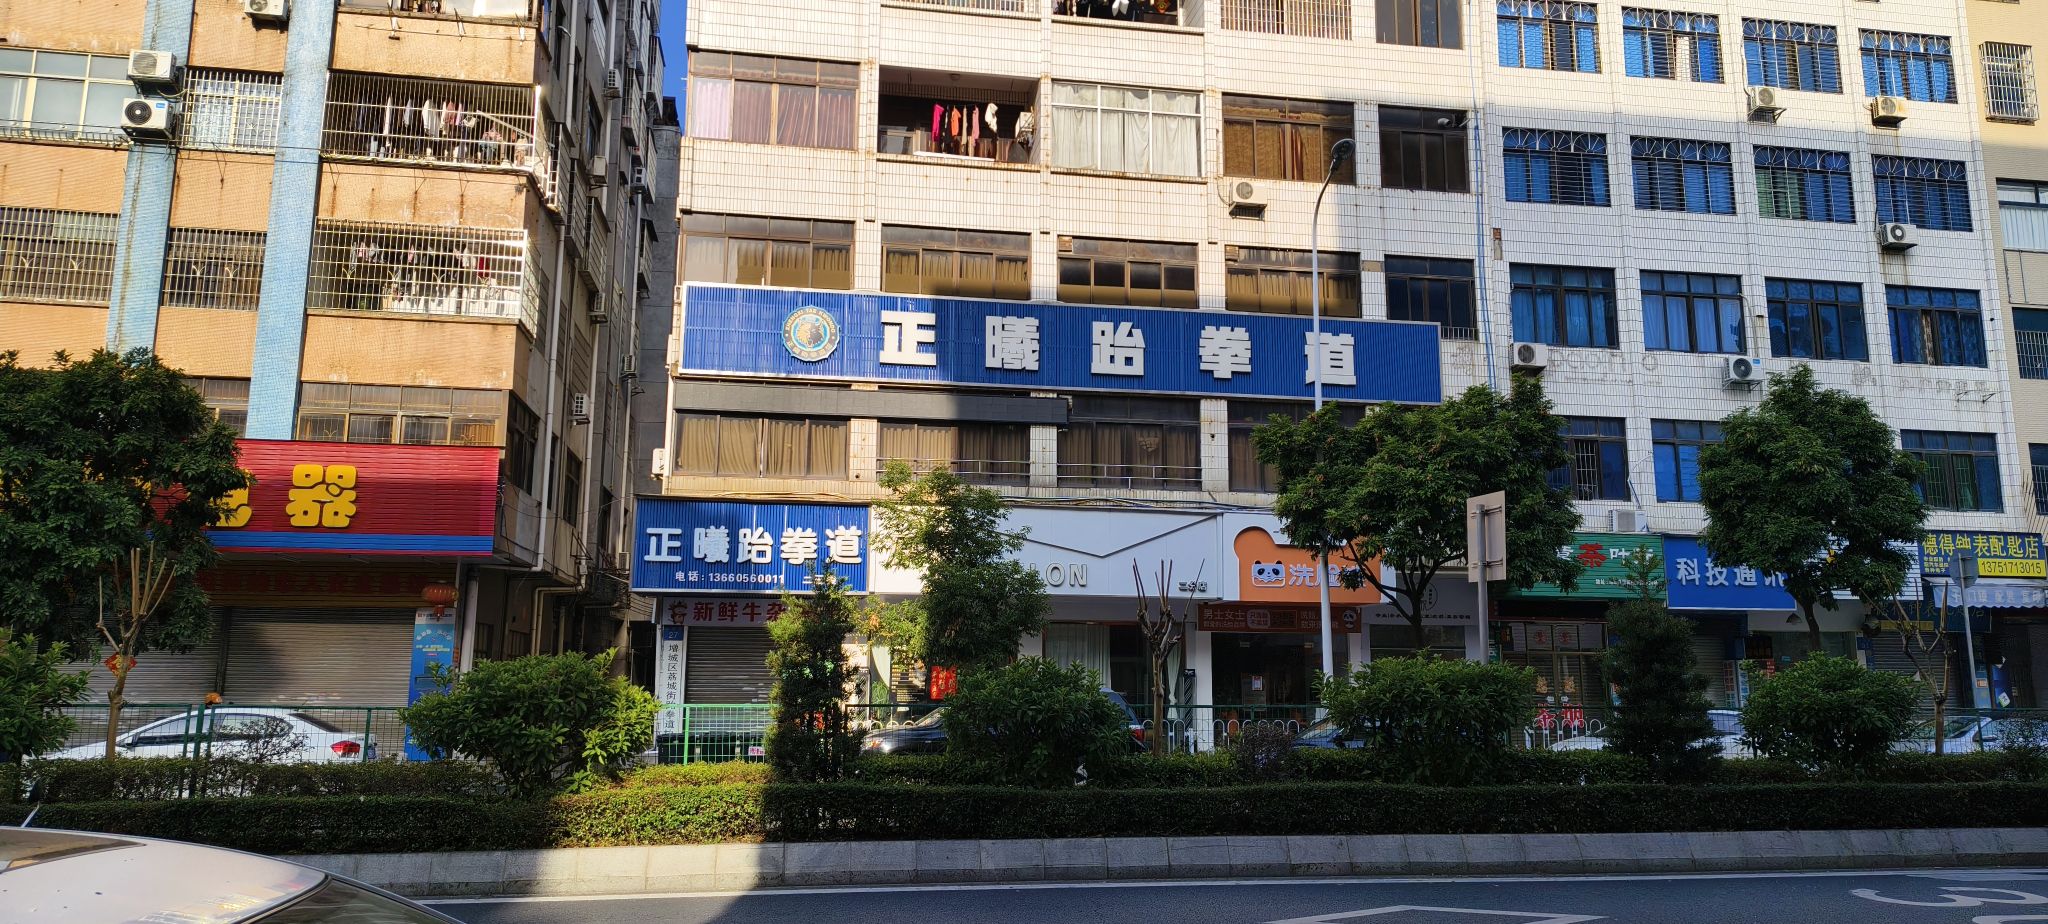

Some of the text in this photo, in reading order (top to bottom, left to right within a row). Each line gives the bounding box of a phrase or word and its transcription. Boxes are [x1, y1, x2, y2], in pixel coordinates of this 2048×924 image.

[880, 310, 1357, 386] 正曦跆拳道
[644, 525, 862, 565] 正曦跆拳道
[1289, 563, 1366, 587] 洗脸
[1981, 561, 2042, 574] 13751713015
